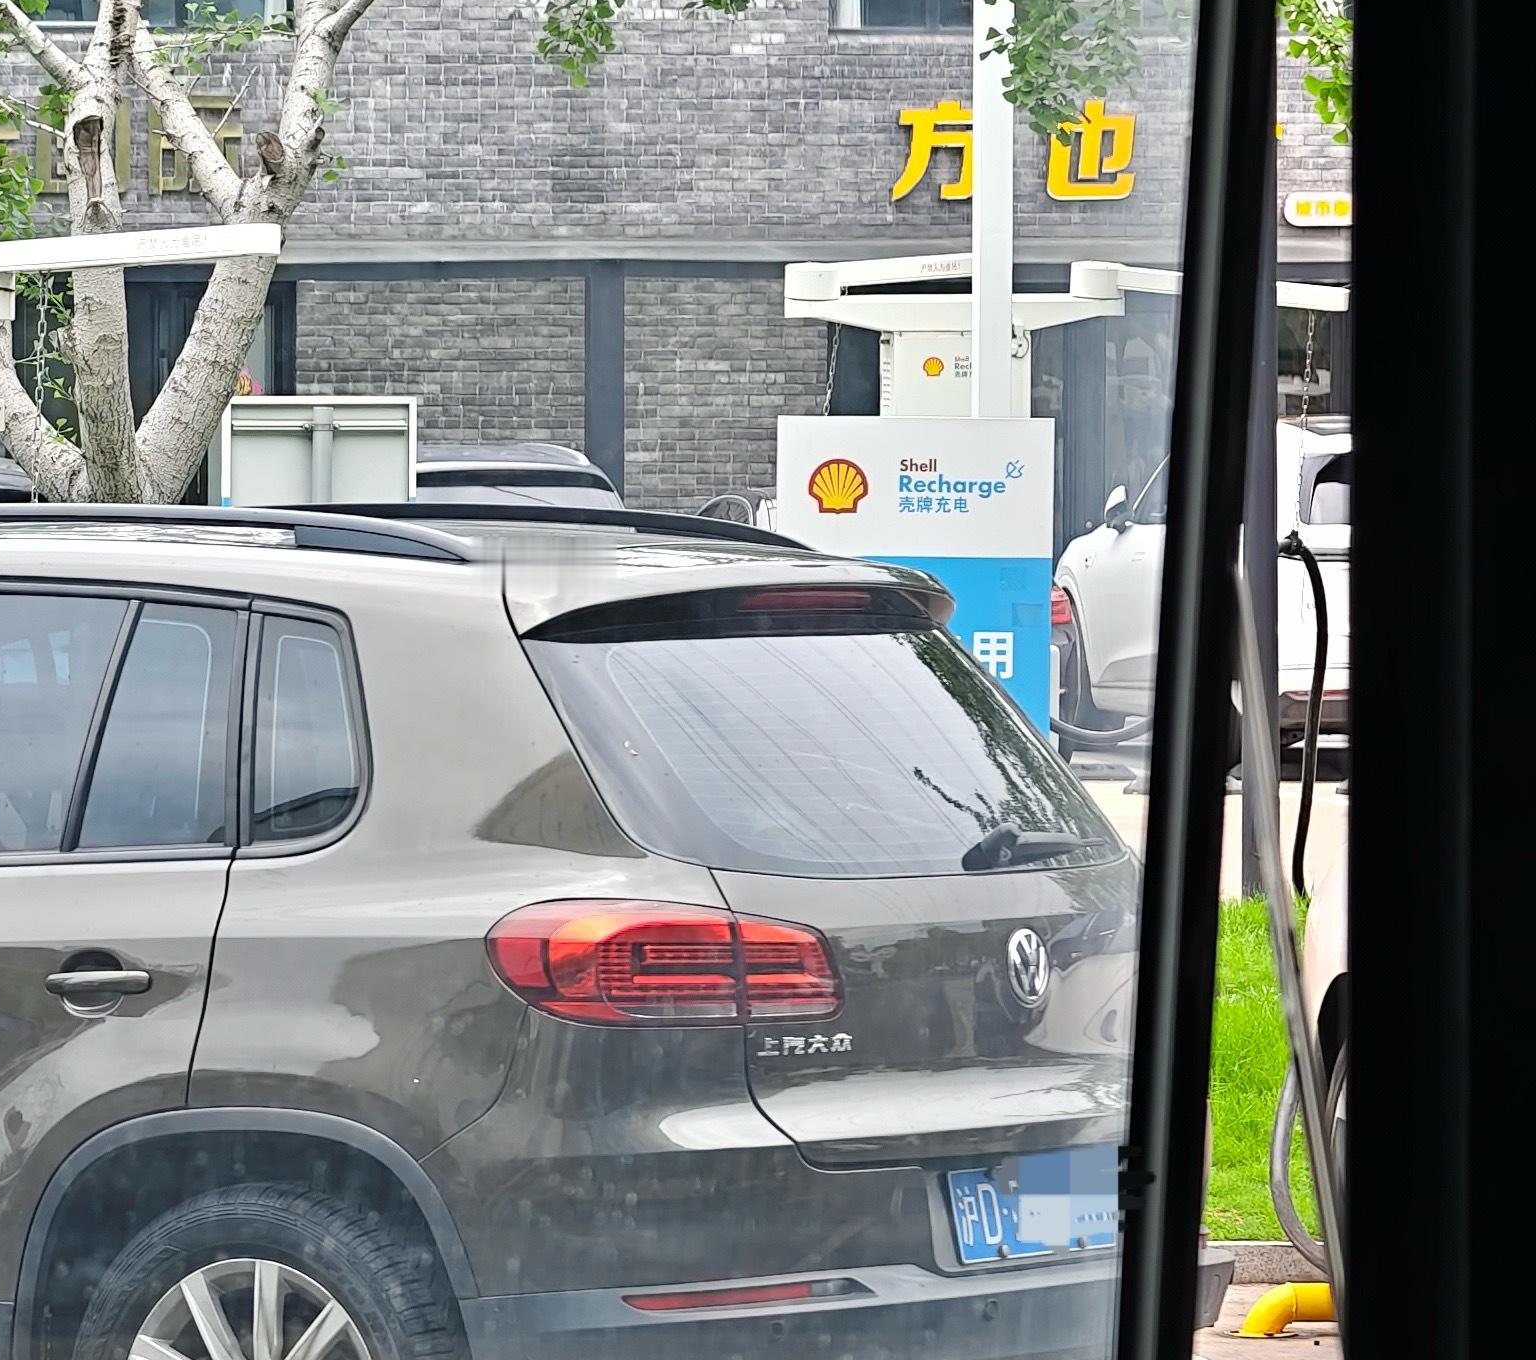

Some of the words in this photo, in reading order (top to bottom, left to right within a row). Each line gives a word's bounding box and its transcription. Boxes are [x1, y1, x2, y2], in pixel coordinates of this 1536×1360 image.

[899, 458, 938, 473] Shell
[898, 473, 1007, 498] Recharge
[898, 497, 970, 513] 壳牌充电
